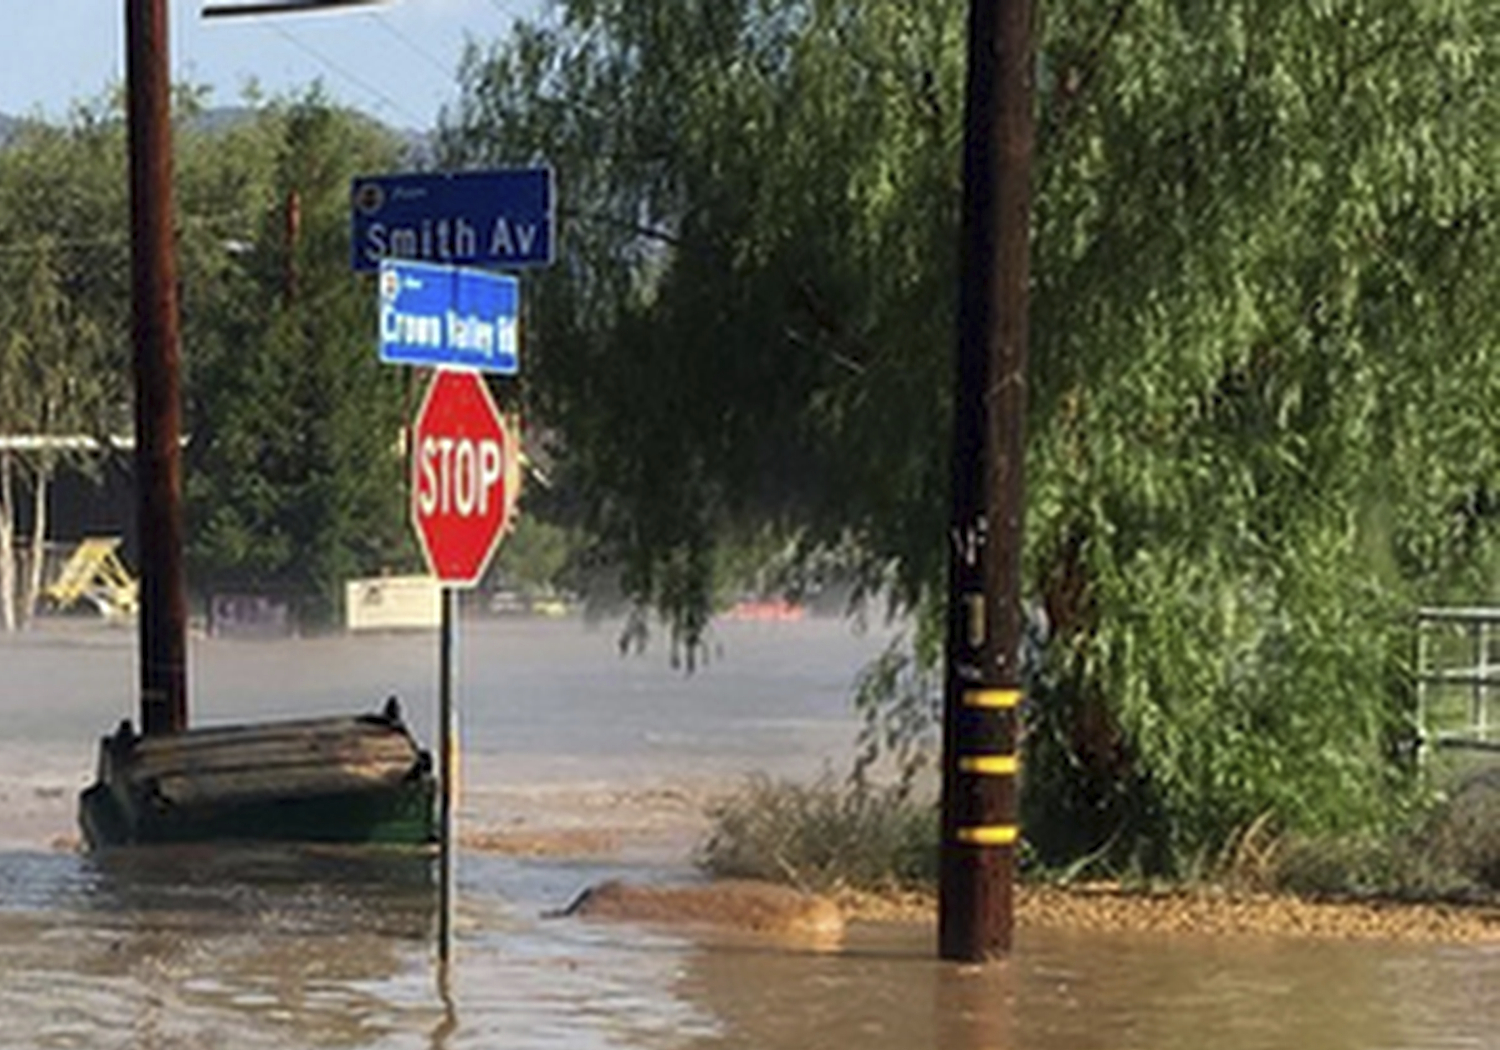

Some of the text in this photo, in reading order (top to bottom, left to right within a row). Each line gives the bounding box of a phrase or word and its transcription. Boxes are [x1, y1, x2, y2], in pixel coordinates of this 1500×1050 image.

[364, 216, 537, 261] Smith Av
[380, 304, 441, 349] Crown
[418, 435, 501, 517] STOP
